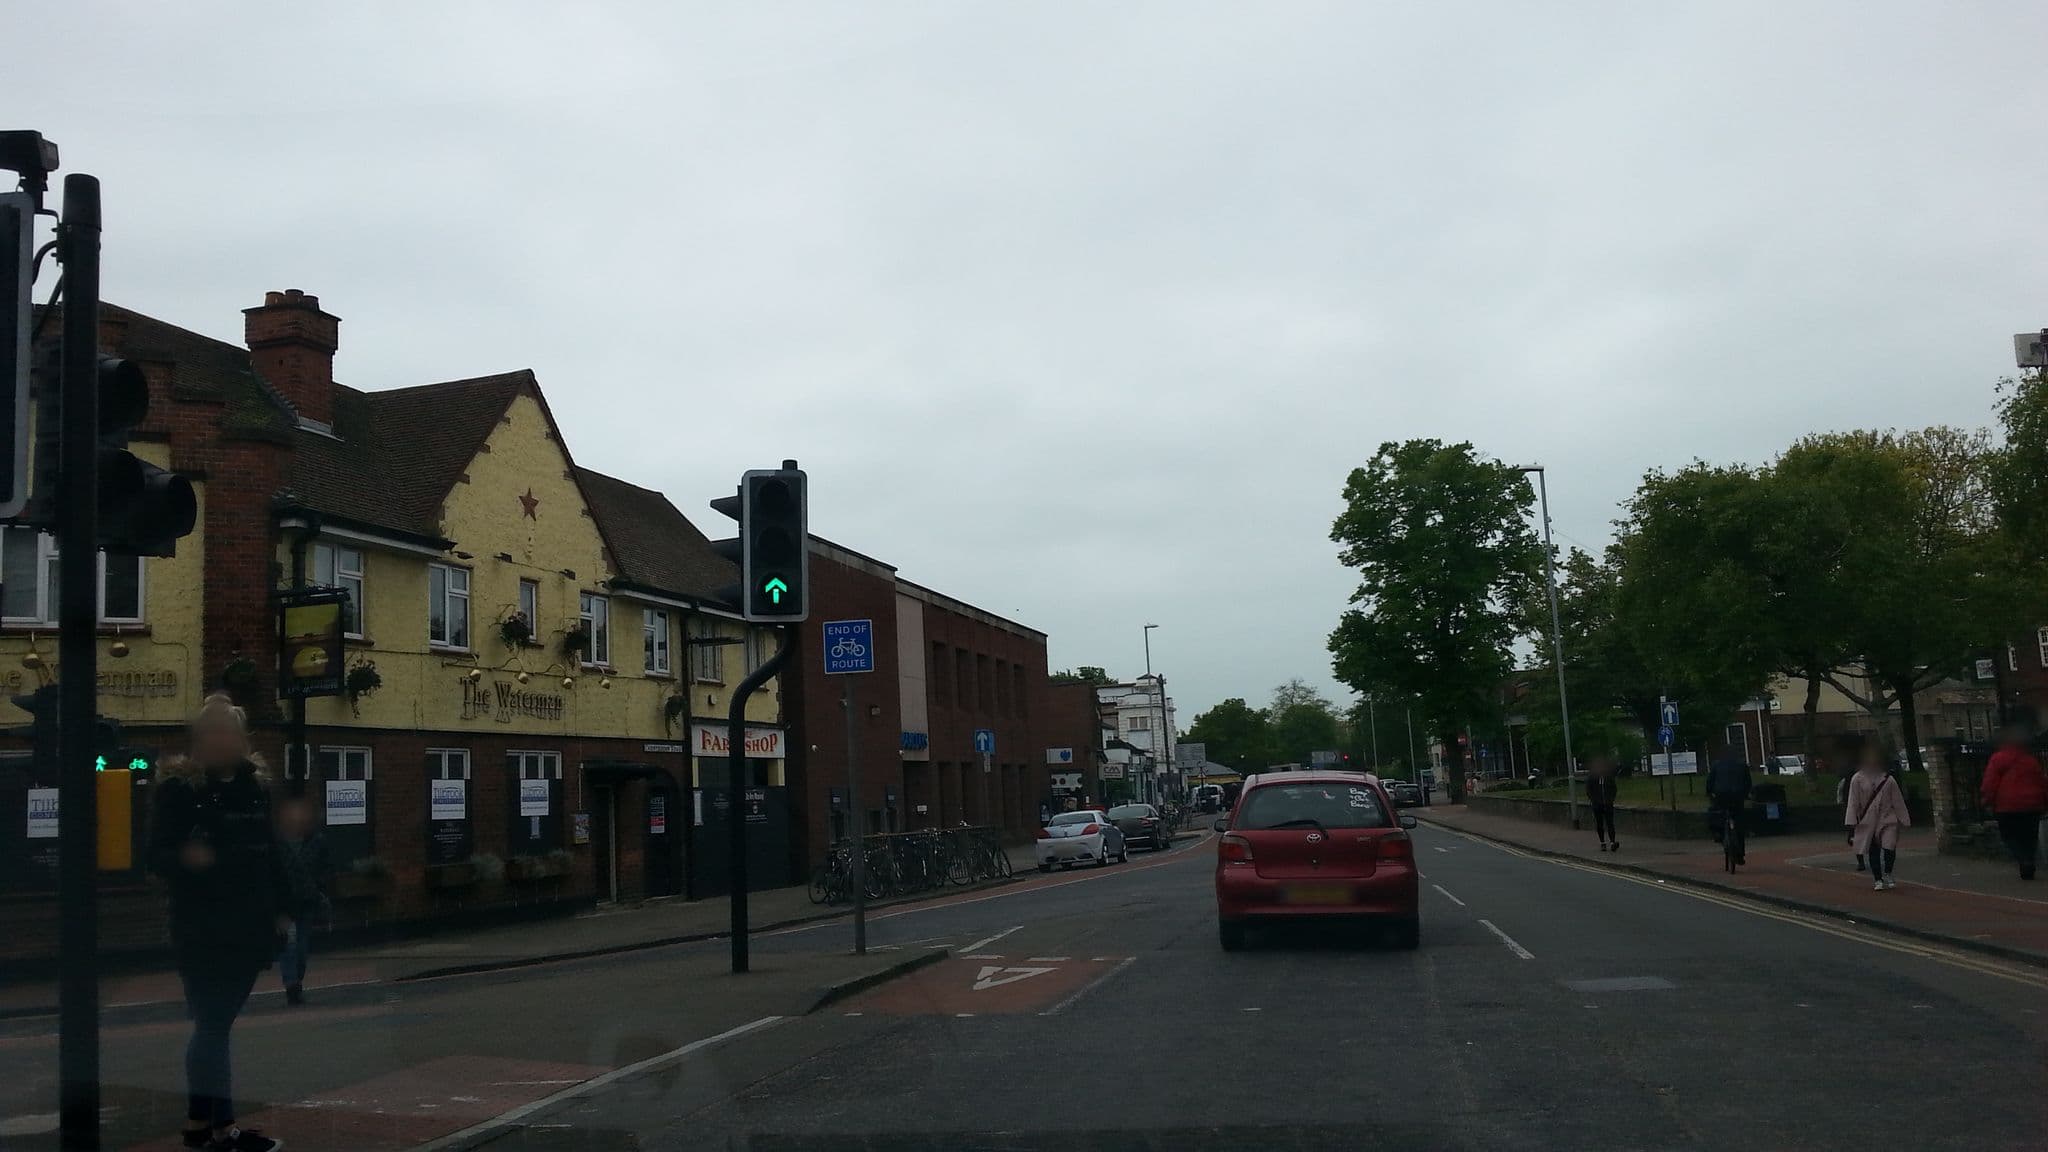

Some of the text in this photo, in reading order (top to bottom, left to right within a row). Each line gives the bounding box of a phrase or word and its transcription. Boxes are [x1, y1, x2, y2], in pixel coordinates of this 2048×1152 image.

[828, 624, 868, 635] END OF
[832, 658, 866, 669] ROUTE
[459, 677, 562, 709] The Waterman
[745, 733, 778, 752] SHOP
